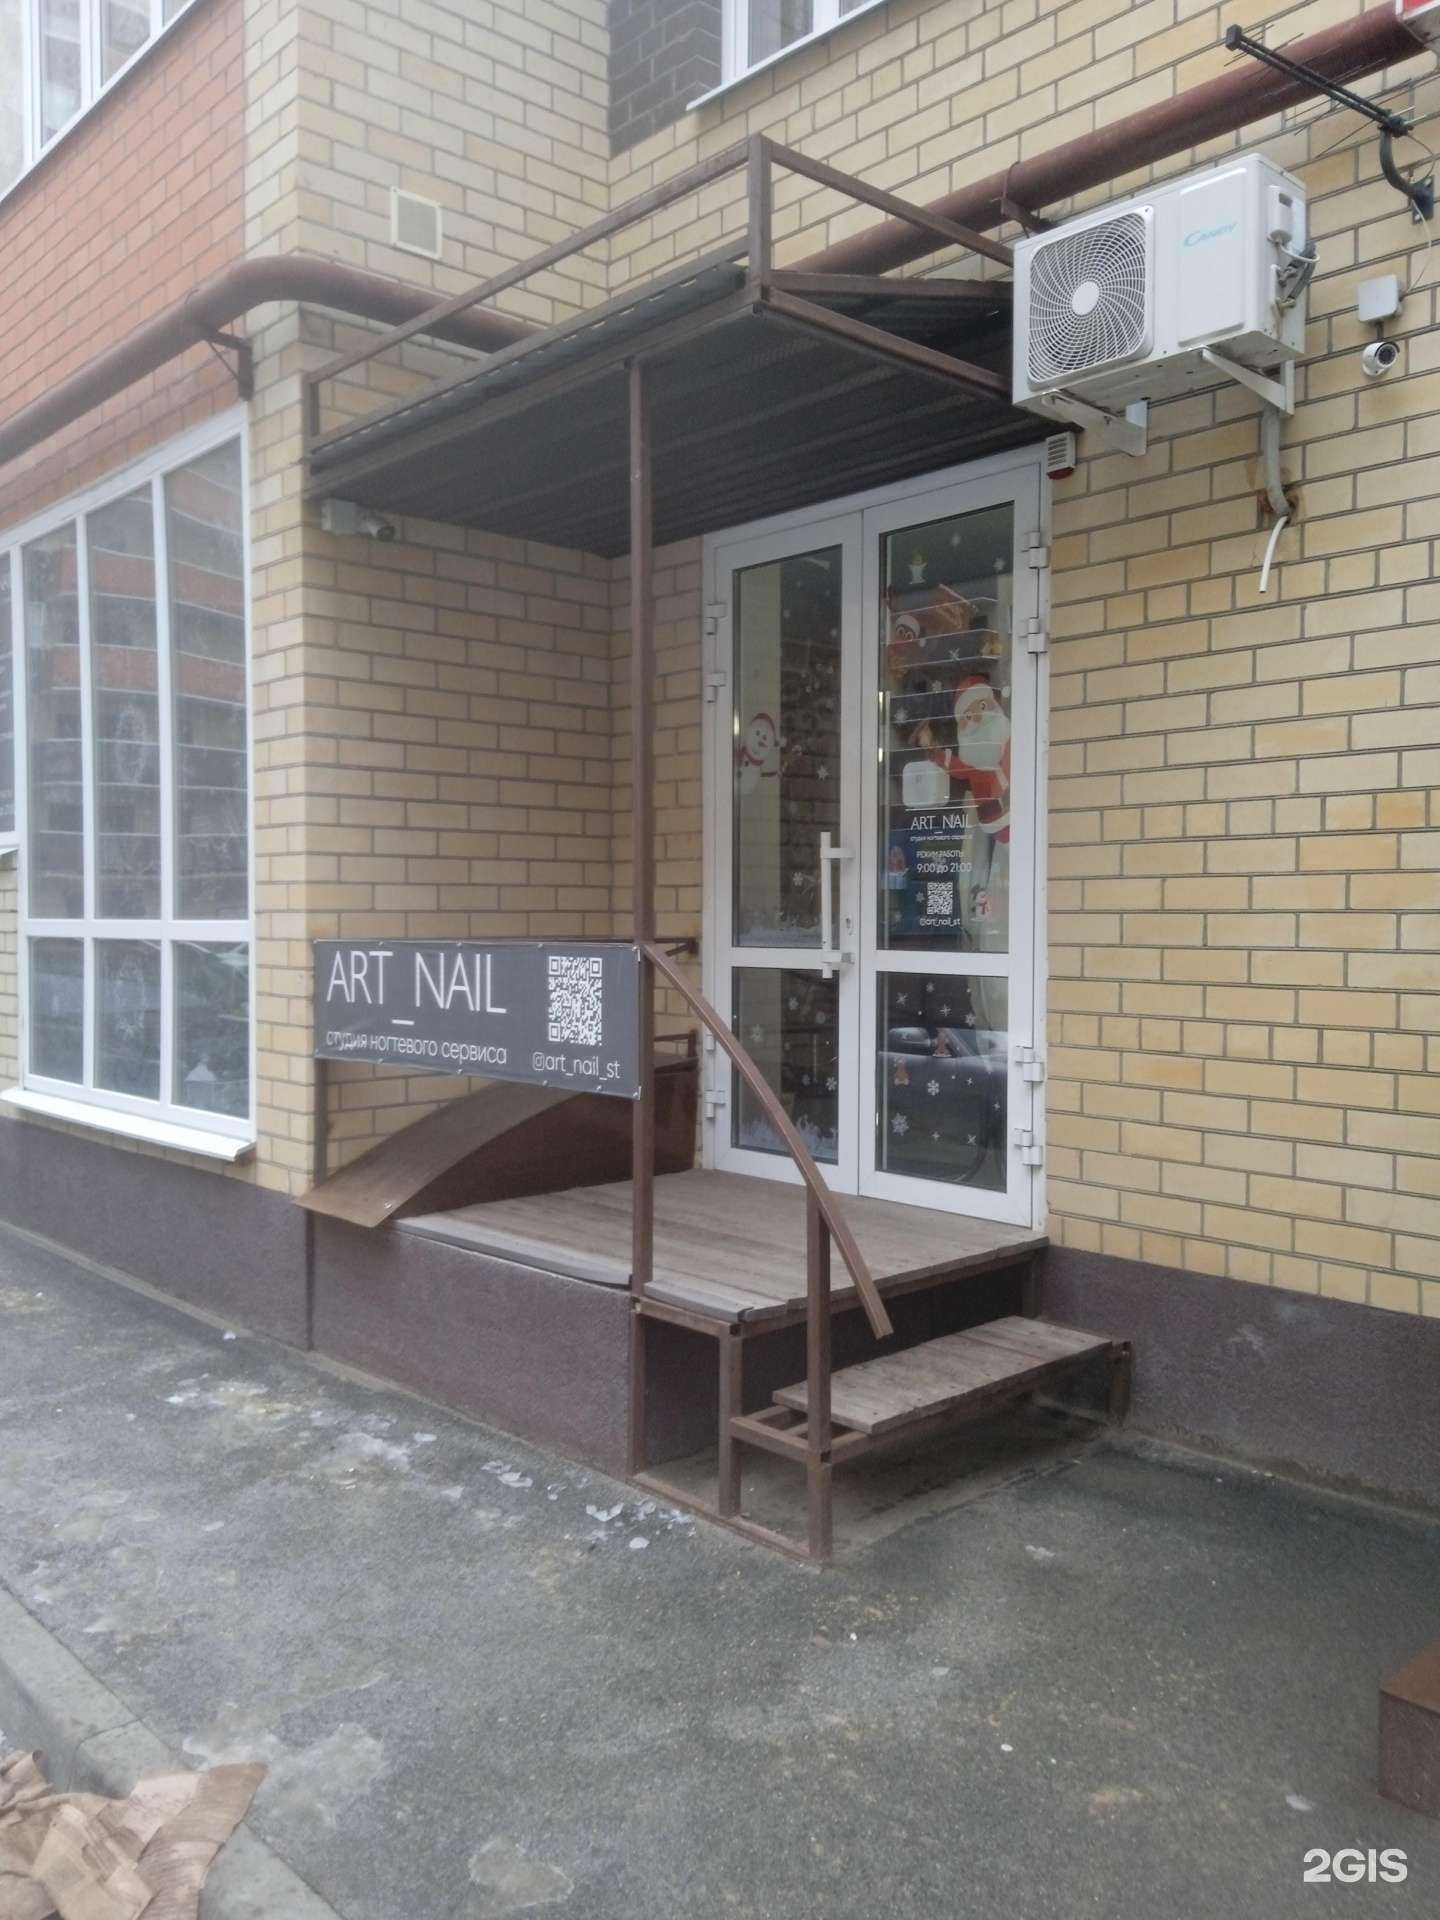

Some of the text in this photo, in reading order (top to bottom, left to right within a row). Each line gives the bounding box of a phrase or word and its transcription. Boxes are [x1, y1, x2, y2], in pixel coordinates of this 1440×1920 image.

[326, 1031, 507, 1065] студия ногтевого сервиса
[532, 1051, 621, 1081] @art_nail_st
